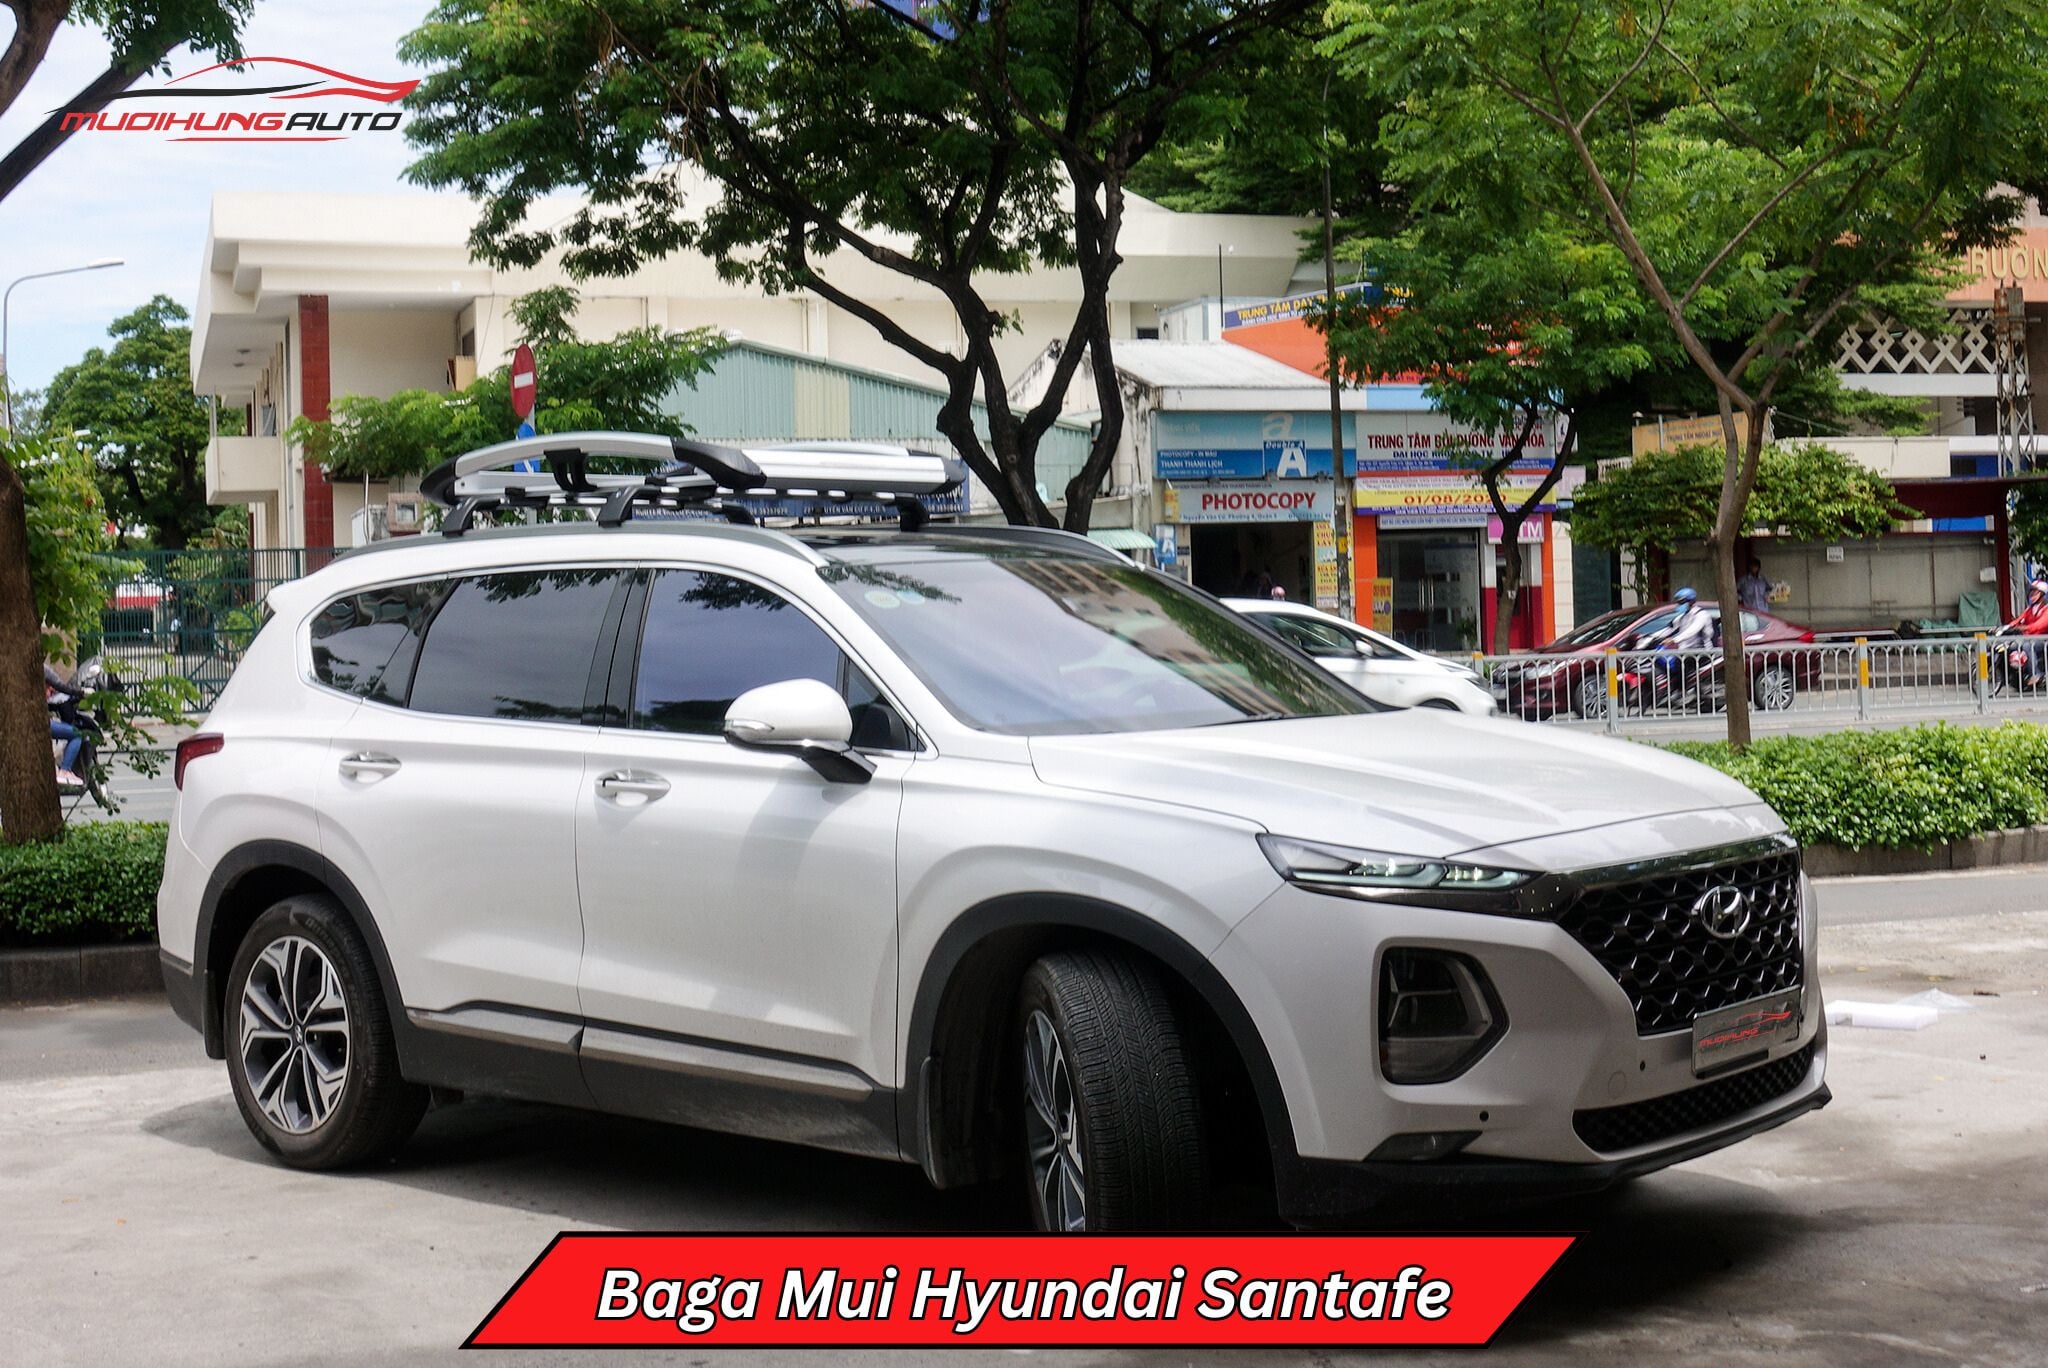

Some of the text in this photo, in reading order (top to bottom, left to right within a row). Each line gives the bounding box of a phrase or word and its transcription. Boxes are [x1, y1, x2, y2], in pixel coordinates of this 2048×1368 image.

[1237, 305, 1268, 321] TRUNG
[1270, 300, 1291, 314] TÂM
[1367, 434, 1404, 449] TRUNG
[1408, 431, 1431, 449] TÂM
[1276, 447, 1307, 477] A
[1410, 450, 1428, 460] HỌC
[1202, 493, 1316, 510] PHOTOCOPY
